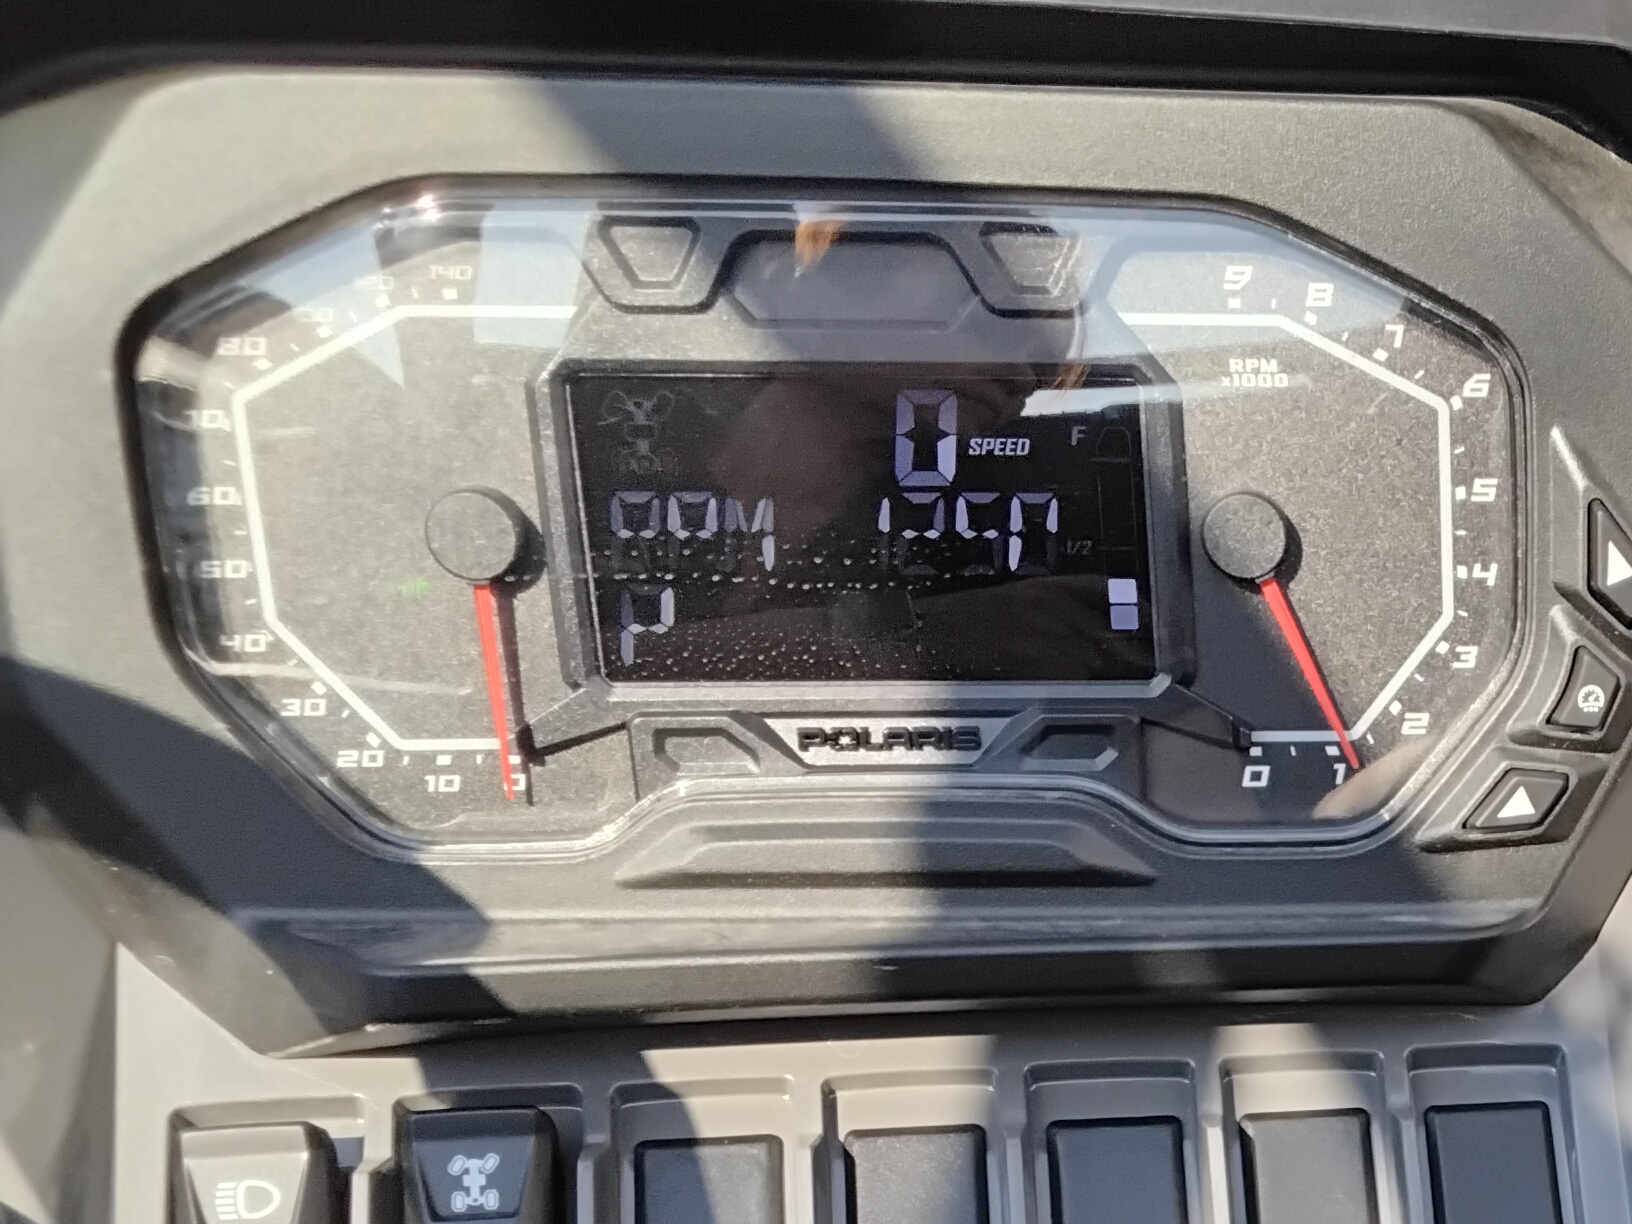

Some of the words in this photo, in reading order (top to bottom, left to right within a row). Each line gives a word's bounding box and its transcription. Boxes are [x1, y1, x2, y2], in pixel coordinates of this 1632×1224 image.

[1223, 266, 1252, 290] 9
[1306, 282, 1334, 307] 8
[1385, 324, 1404, 348] 7
[1229, 359, 1277, 373] RPM
[1463, 374, 1491, 398] 6
[895, 389, 957, 487] 0
[969, 437, 1030, 457] SPEED
[1471, 478, 1498, 502] 5
[1472, 563, 1498, 586] 4
[219, 633, 268, 652] 40
[1453, 645, 1478, 669] 3
[281, 699, 326, 717] 30
[1401, 712, 1430, 735] 2
[797, 725, 982, 752] POLARIS
[336, 750, 384, 768] 20
[424, 775, 460, 792] 10
[1242, 765, 1270, 788] 0
[1333, 763, 1346, 785] 1
